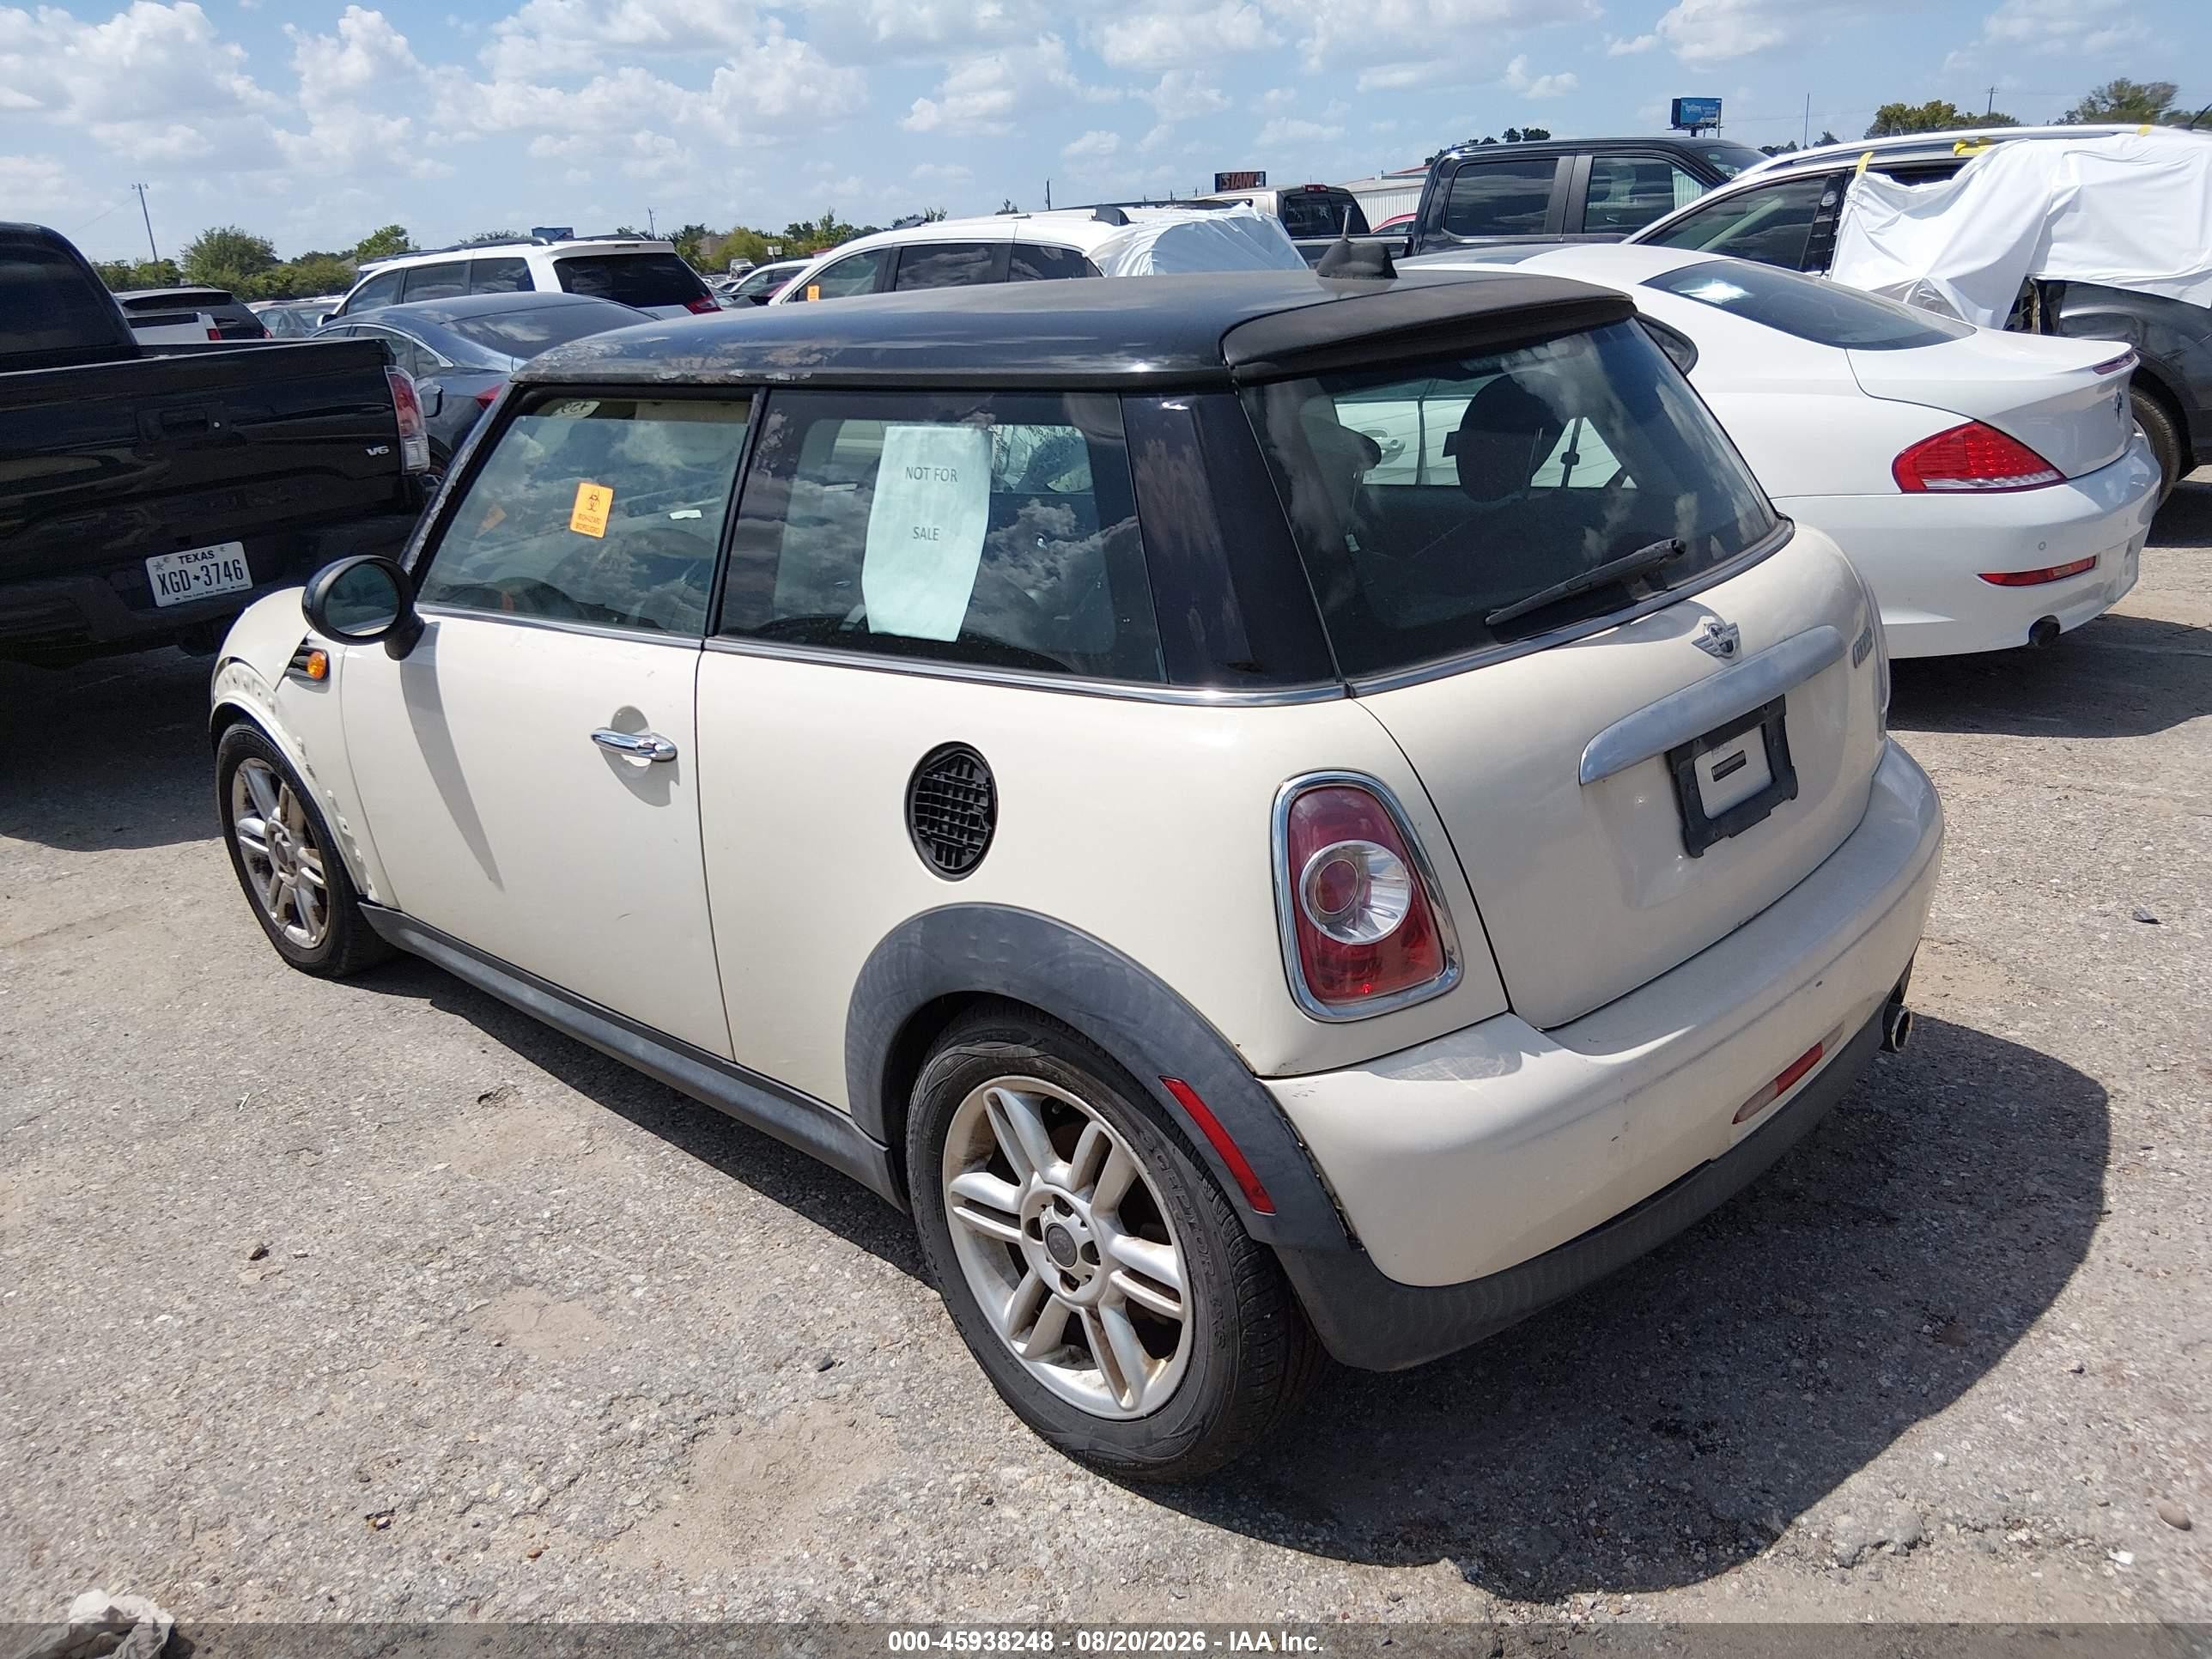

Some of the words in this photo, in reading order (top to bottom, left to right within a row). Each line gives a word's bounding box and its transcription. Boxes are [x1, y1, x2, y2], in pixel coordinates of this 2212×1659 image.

[365, 446, 390, 455] V6
[905, 466, 932, 481] NOT
[933, 468, 958, 483] FOR
[913, 526, 940, 541] SALE
[178, 550, 216, 564] TEXAS
